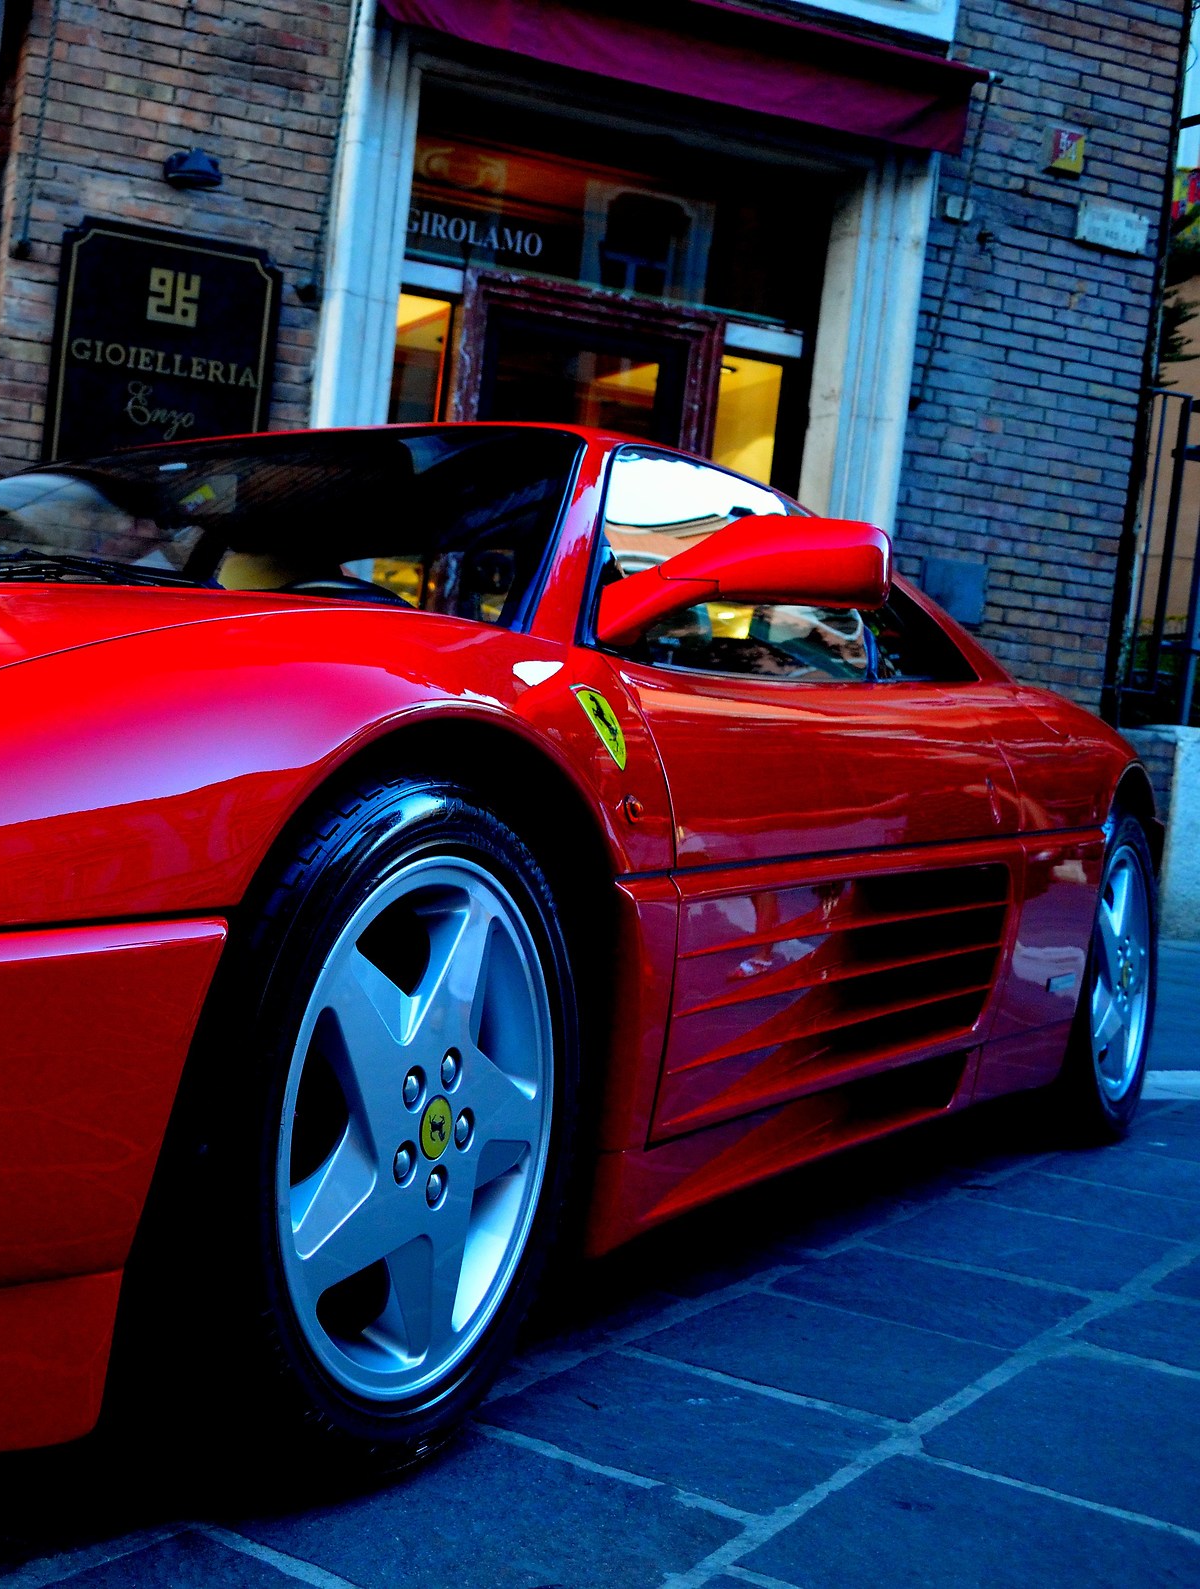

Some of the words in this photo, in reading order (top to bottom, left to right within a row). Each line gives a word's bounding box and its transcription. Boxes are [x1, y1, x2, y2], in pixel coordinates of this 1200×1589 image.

[407, 207, 543, 257] GIROLAMO
[71, 338, 259, 389] GIOIELLERIA
[124, 380, 195, 440] Enzo
